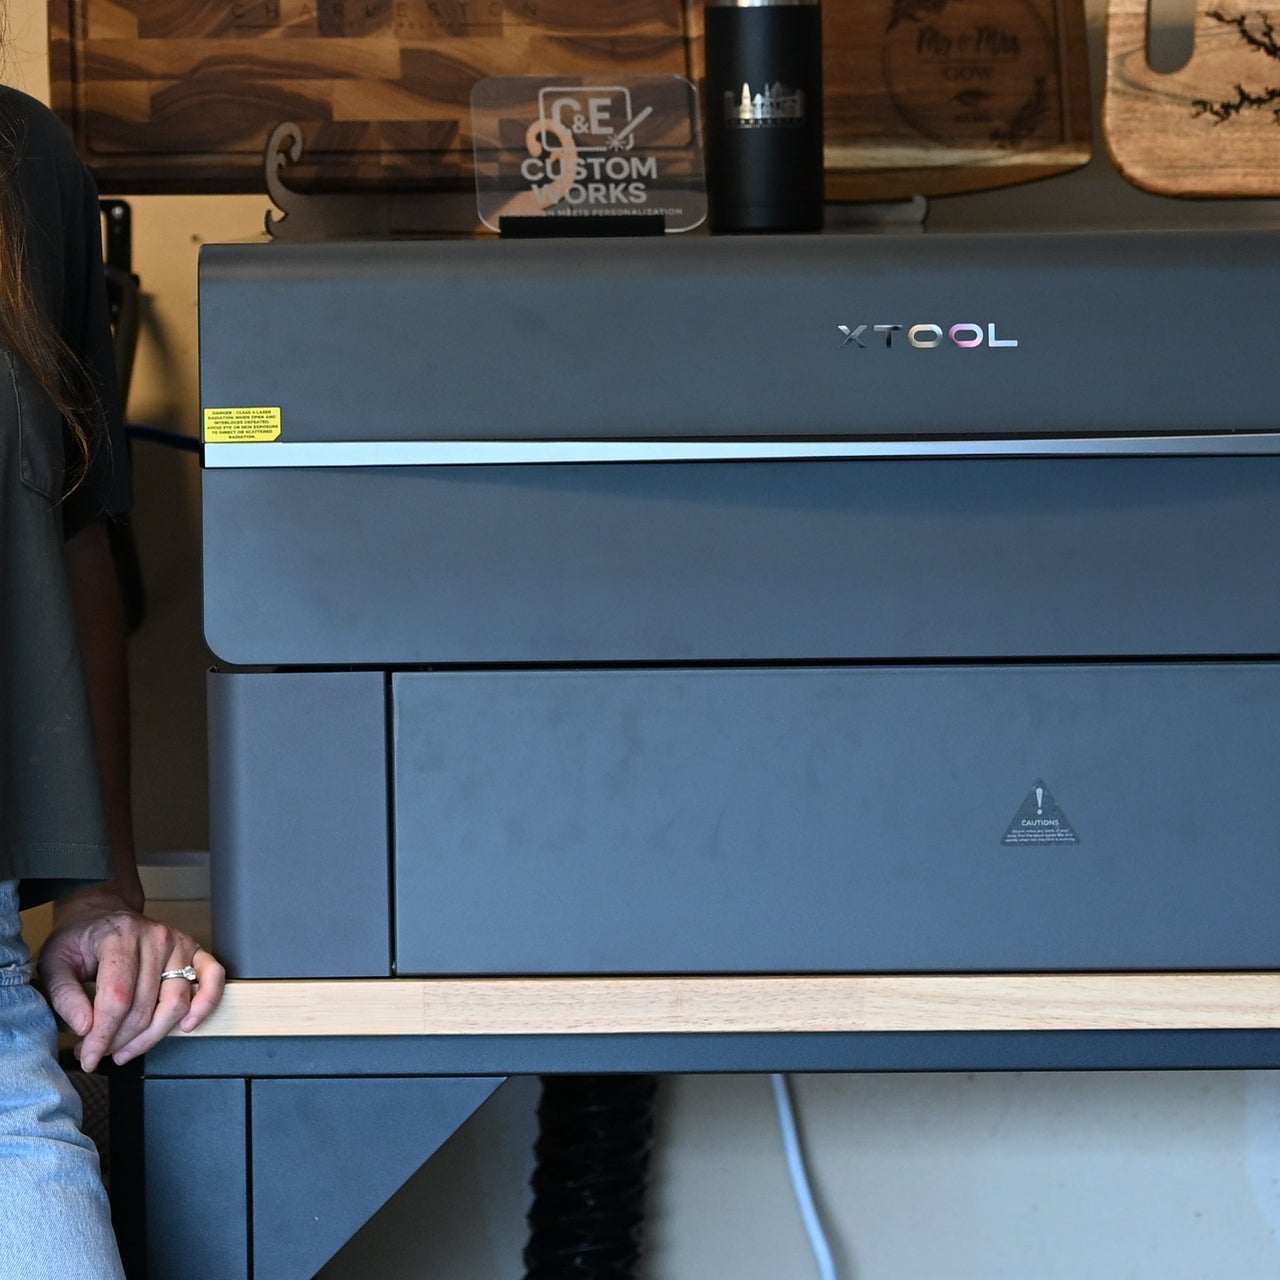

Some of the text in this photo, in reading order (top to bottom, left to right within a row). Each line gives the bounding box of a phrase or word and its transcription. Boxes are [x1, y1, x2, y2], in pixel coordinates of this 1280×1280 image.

[551, 97, 614, 135] C&E
[521, 156, 658, 180] CUSTOM
[531, 182, 647, 205] WORKS
[592, 207, 683, 216] PERSONALIZATION
[837, 322, 1019, 349] XTOOL
